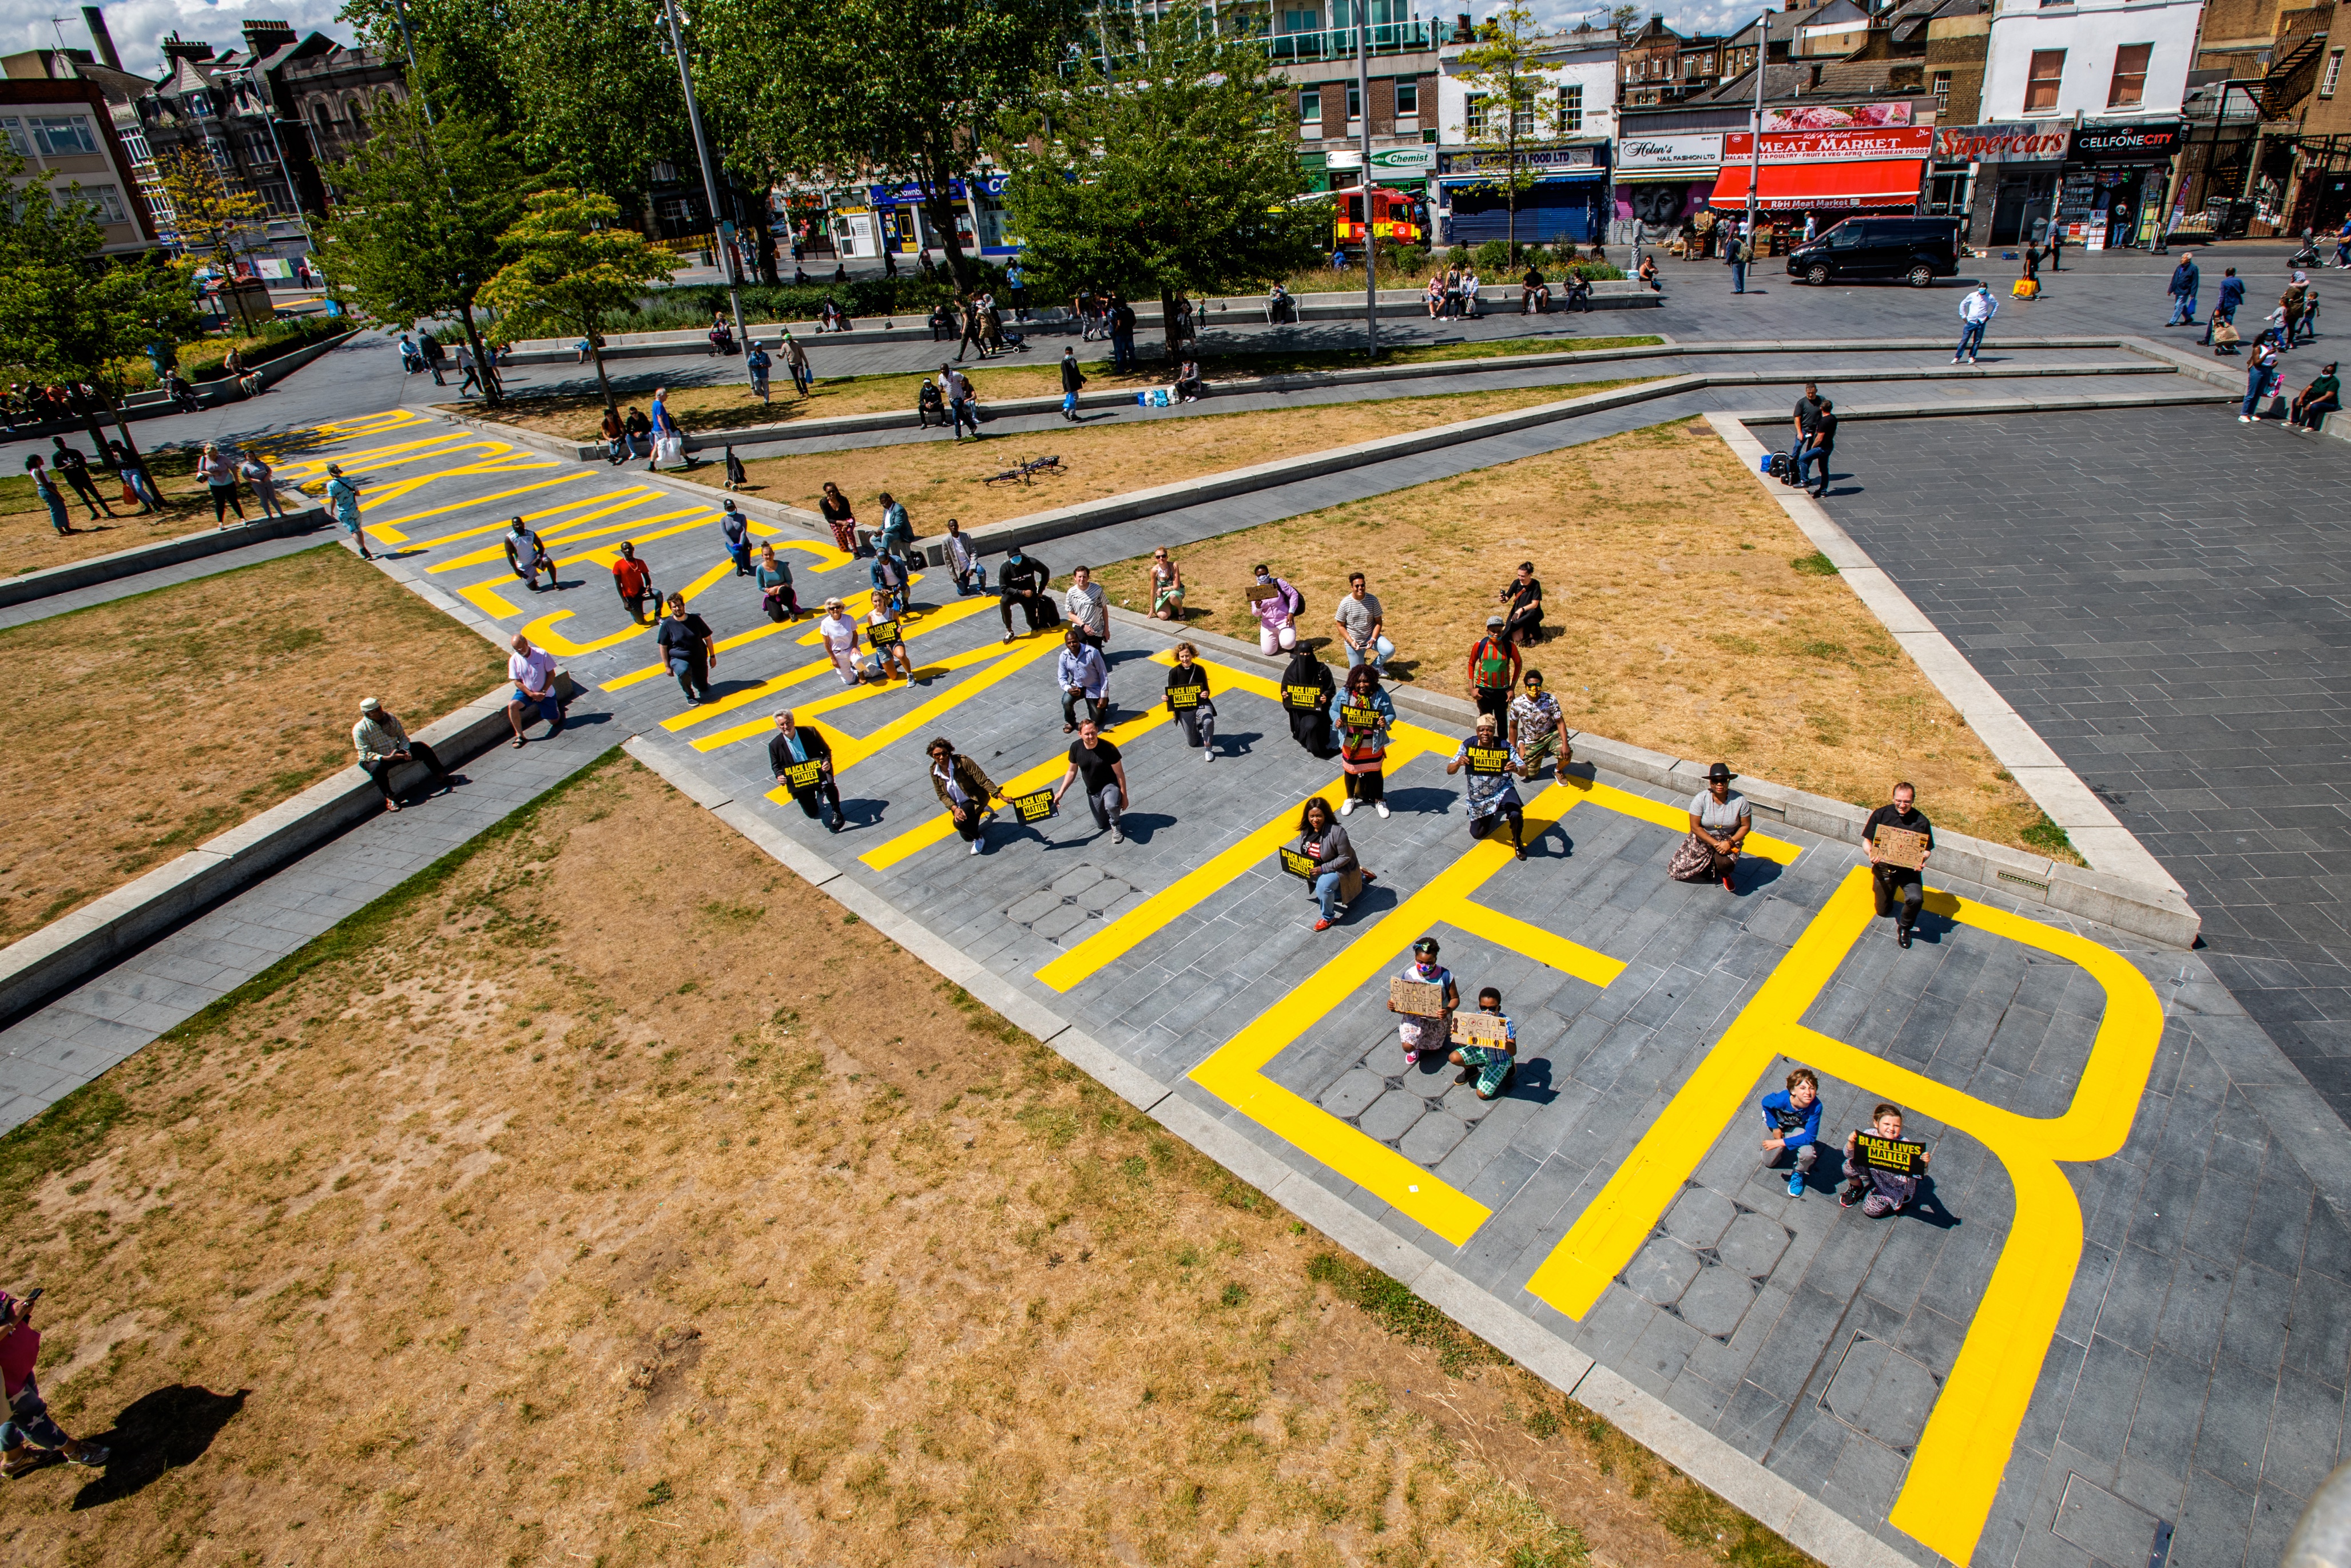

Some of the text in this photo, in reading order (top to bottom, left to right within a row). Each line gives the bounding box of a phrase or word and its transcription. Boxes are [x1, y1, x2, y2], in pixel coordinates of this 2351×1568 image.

[1916, 129, 1930, 137] حلال
[1624, 141, 1673, 157] Helen's
[1758, 138, 1901, 152] MEAT MARKET
[1938, 128, 2065, 162] Supercars
[1391, 153, 1428, 163] Chemist
[1528, 153, 1551, 164] FOOD
[1554, 152, 1570, 162] LTD
[869, 622, 896, 634] BLACK LIVES
[876, 630, 893, 639] MATTER
[1167, 686, 1185, 696] BLACK
[1287, 685, 1320, 695] BLACK LIVES
[1175, 694, 1195, 702] MATTER
[1293, 694, 1313, 702] MATTER
[1343, 706, 1361, 716] BLACK
[1468, 747, 1508, 759] BLACK LIVES
[785, 760, 821, 776] BLACK LIVES
[794, 771, 816, 782] MATTER
[1015, 792, 1052, 808] BLACK LIVES
[1024, 803, 1047, 815] MATTER
[1880, 827, 1920, 845] BLACK
[1881, 839, 1920, 855] LIVES
[1281, 849, 1314, 868] BLACK LIVES
[1289, 859, 1308, 873] MATTER
[1393, 979, 1439, 999] BLACK
[1392, 993, 1436, 1006] CHILDREN
[1460, 1017, 1503, 1031] SOCIAL
[1460, 1027, 1504, 1040] JUSTICE
[1858, 1135, 1921, 1155] BLACK LIVES
[1871, 1148, 1908, 1163] MATTER
[1868, 1158, 1892, 1167] Equalities
